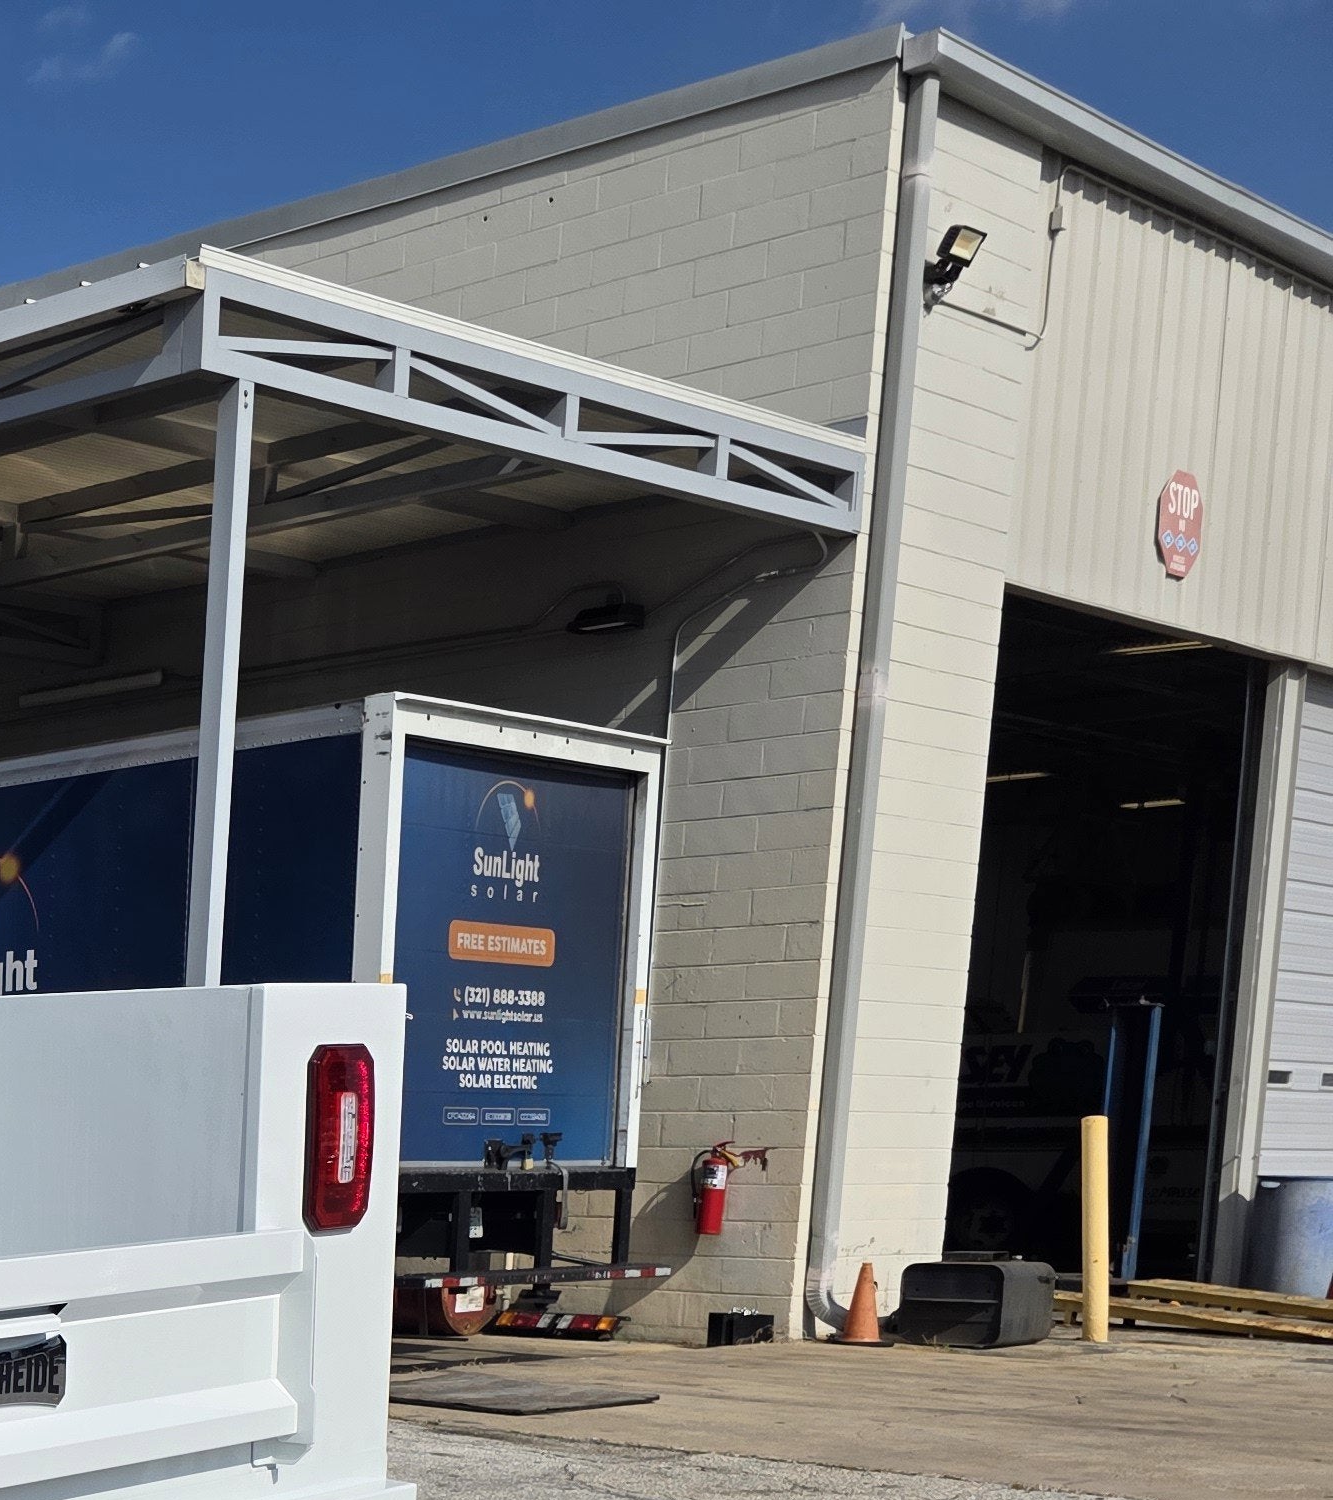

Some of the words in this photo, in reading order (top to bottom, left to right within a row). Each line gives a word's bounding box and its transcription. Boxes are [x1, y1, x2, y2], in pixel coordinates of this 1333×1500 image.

[1168, 481, 1199, 520] STOP
[473, 846, 540, 887] SunLight
[470, 884, 538, 902] solar
[457, 932, 485, 950] FREE
[487, 935, 546, 955] ESTIMATES
[464, 985, 490, 1007] (321)
[446, 1038, 479, 1054] SOLAR
[481, 1040, 507, 1055] POOL
[509, 1041, 550, 1057] HEATING
[442, 1055, 475, 1071] SOLAR
[477, 1056, 510, 1072] WATER
[512, 1058, 553, 1073] HEATING
[459, 1073, 491, 1088] SOLAR
[493, 1074, 537, 1090] ELECTRIC
